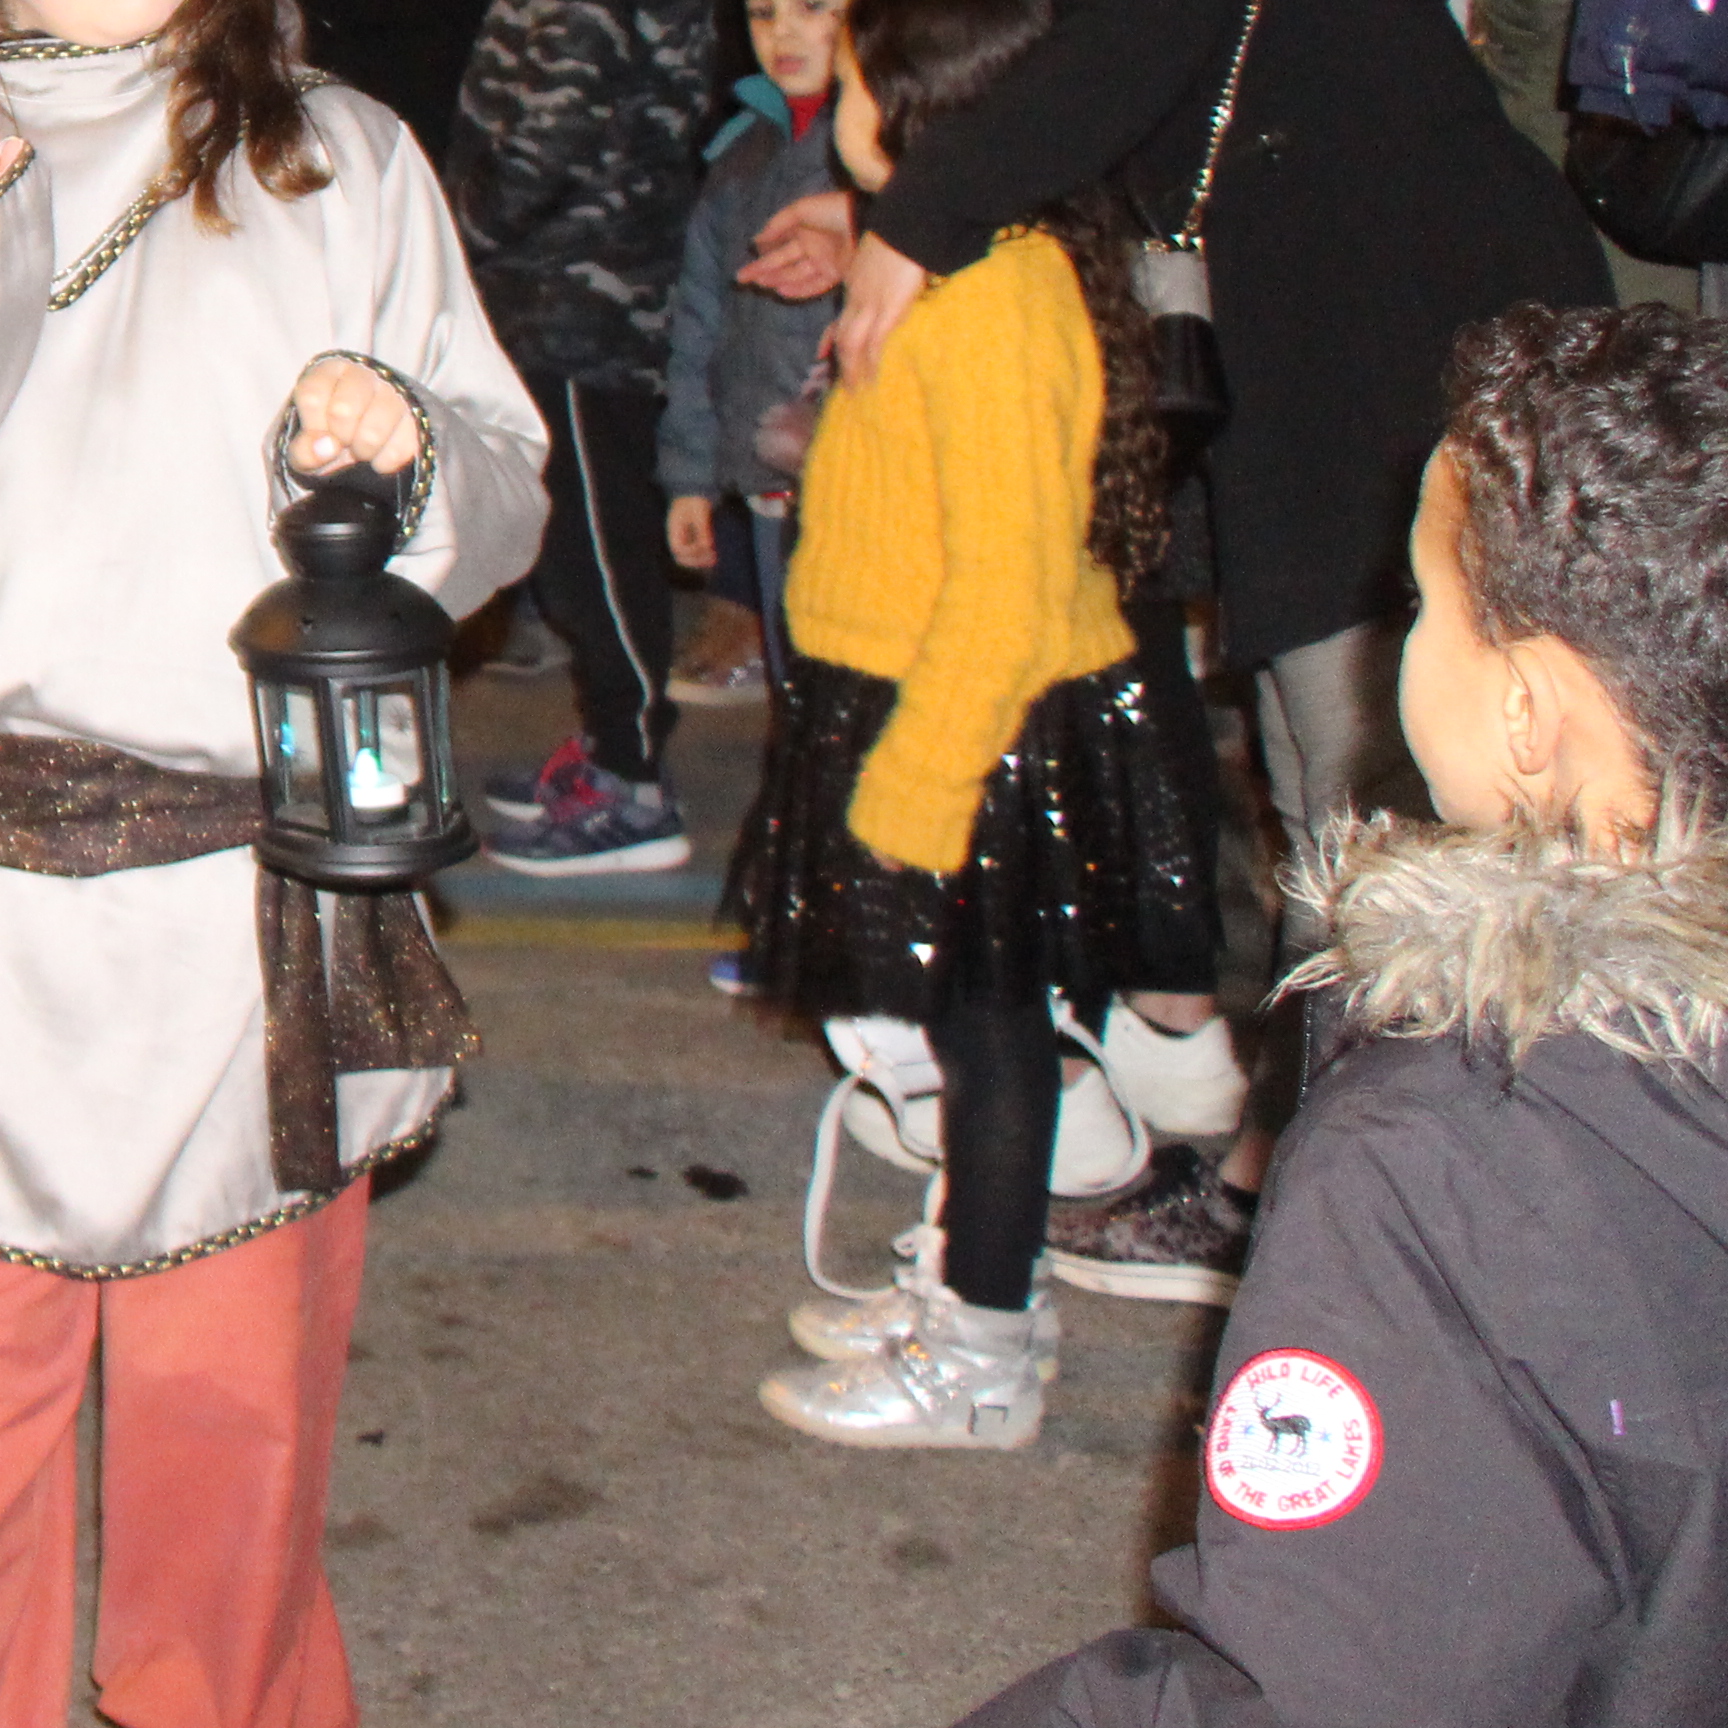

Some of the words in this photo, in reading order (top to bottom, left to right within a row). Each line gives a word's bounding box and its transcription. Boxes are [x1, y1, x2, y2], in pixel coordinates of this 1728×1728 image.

[1299, 1364, 1345, 1400] LIFE
[1233, 1480, 1269, 1510] THE
[1277, 1479, 1338, 1513] GREAT
[1335, 1417, 1364, 1480] LAKES
